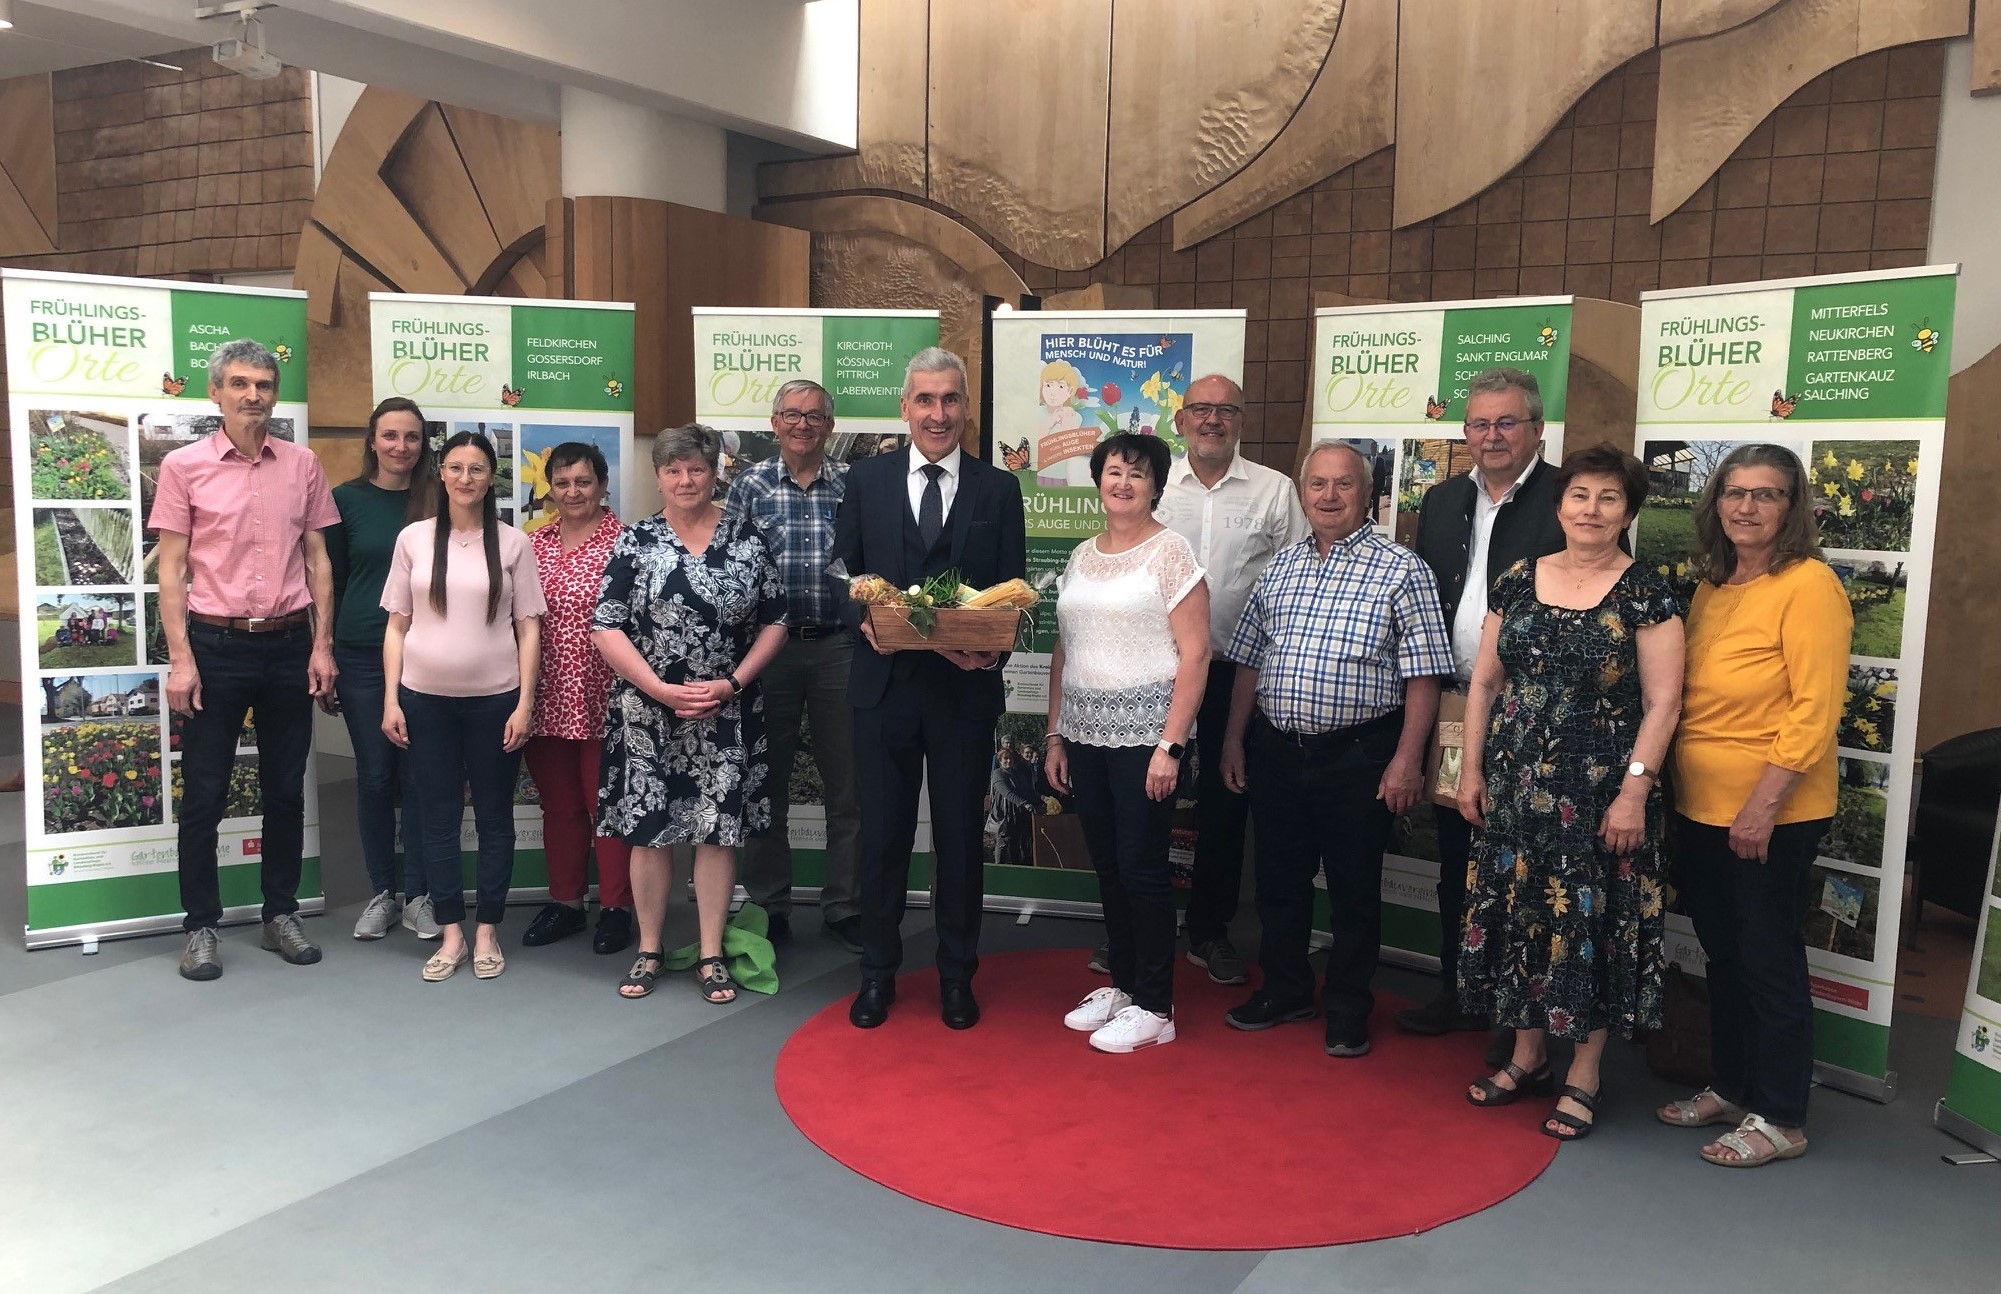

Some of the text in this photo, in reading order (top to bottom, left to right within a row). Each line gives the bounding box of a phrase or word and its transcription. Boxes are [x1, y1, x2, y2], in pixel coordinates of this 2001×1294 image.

[30, 299, 146, 320] FRÜHLINGS-
[1811, 303, 1888, 320] MITTERFELS
[189, 324, 230, 336] ASCHA
[392, 318, 490, 336] FRÜHLINGS-
[1660, 315, 1765, 336] FRÜHLINGS-
[32, 320, 146, 348] BLÜHER
[712, 331, 802, 347] FRÜHLINGS-
[1332, 331, 1422, 348] FRÜHLINGS-
[1457, 333, 1510, 344] SALCHING
[1809, 326, 1894, 342] NEUKIRCHEN
[190, 342, 221, 352] BACH
[393, 337, 489, 362] BLÜHER
[527, 338, 597, 349] FELDKIRCHEN
[836, 342, 892, 350] KIRCHROTH
[1046, 336, 1164, 358] HIER BLÜHT ES FÜR
[27, 338, 144, 383] Orte
[527, 354, 604, 366] GOSSERSDORF
[713, 350, 802, 372] BLÜHER
[836, 356, 894, 366] KÖSSNACH-
[1045, 350, 1146, 368] MENSCH UND NATUR!
[1456, 350, 1548, 362] SANKT ENGLMAR
[1658, 338, 1762, 368] BLÜHER
[1807, 348, 1893, 363] RATTENBERG
[190, 359, 208, 368] BO
[1331, 350, 1419, 375] BLÜHER
[388, 354, 486, 396] Orte
[527, 370, 570, 381] IRLBACH
[836, 370, 879, 380] PITTRICH
[1805, 370, 1895, 384] GARTENKAUZ
[708, 367, 780, 407] Ort
[1324, 370, 1412, 412] Orte
[1650, 361, 1754, 410] Orte
[1804, 388, 1868, 401] SALCHING
[1062, 438, 1080, 448] AUGE
[1023, 492, 1107, 514] RÜHLIN
[1037, 519, 1070, 529] AUGE
[1074, 520, 1100, 530] UND
[1224, 516, 1264, 530] 1978
